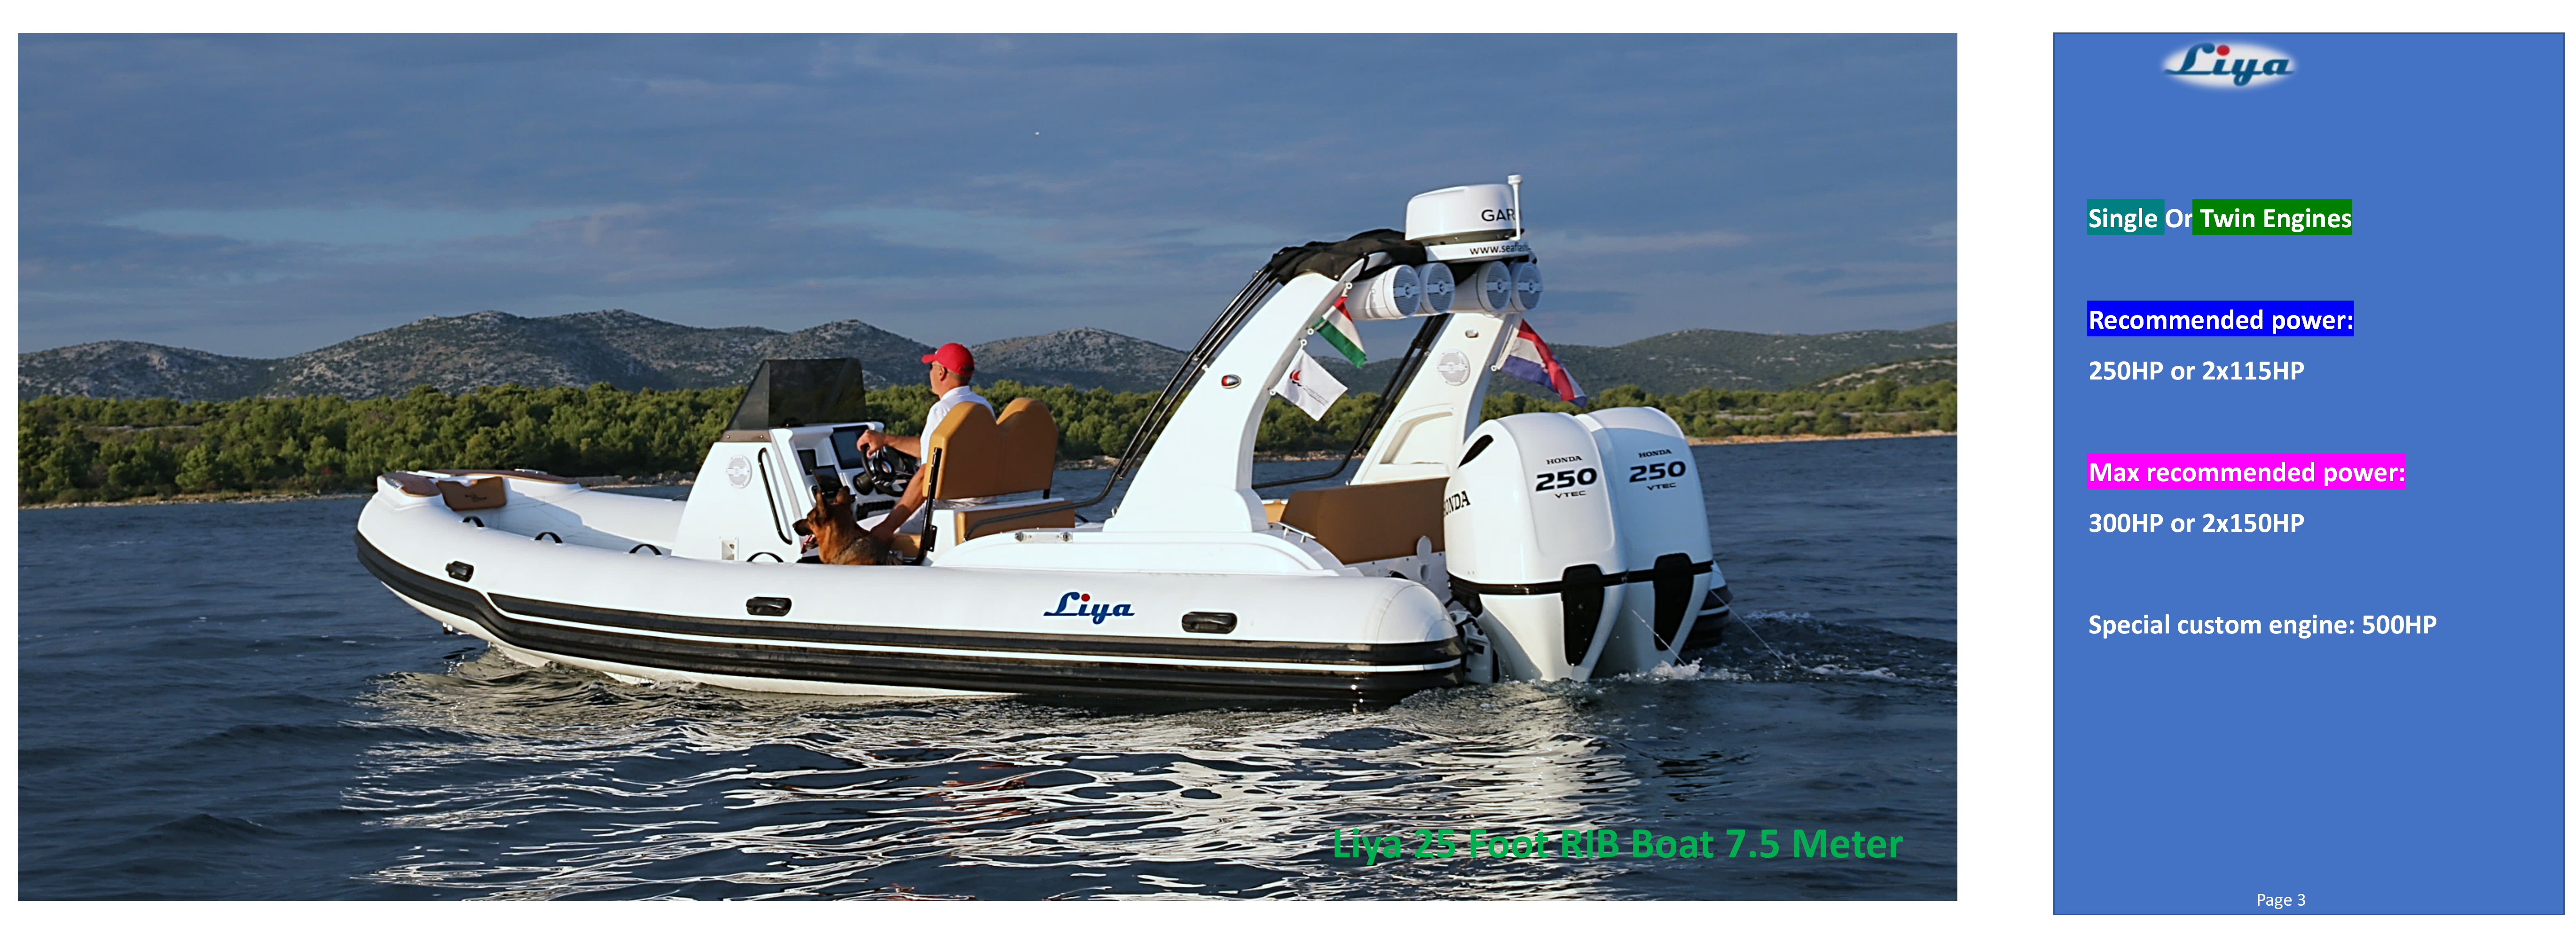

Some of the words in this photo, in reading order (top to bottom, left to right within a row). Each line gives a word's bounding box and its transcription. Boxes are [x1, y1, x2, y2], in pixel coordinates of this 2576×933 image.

[1481, 208, 1521, 221] GAR
[1547, 456, 1582, 465] HONDA
[1638, 449, 1672, 458] HONDA
[1536, 468, 1597, 492] 250
[1629, 461, 1686, 482] 250
[1043, 592, 1135, 625] Liya
